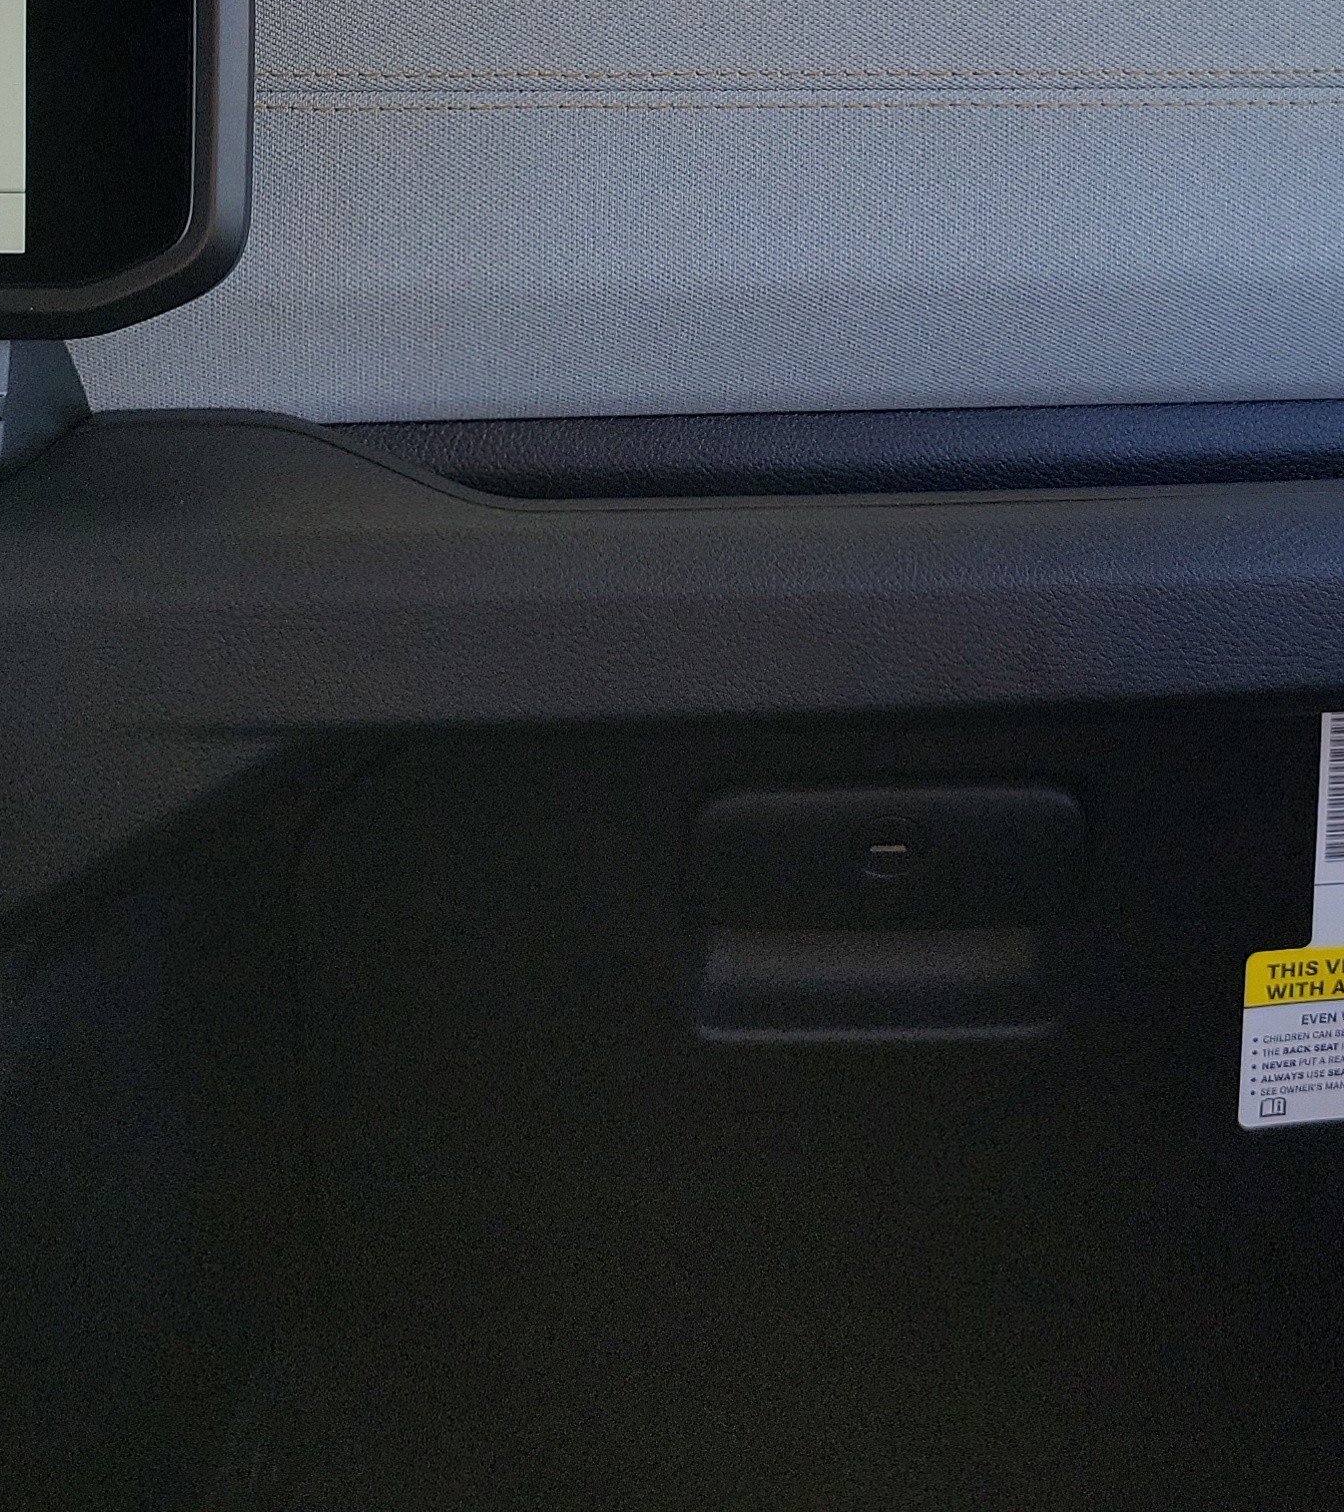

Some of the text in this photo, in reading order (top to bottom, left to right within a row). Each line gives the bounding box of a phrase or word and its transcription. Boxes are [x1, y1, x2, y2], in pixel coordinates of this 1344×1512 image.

[1267, 960, 1319, 979] THIS
[1267, 980, 1324, 1000] WITH
[1301, 1012, 1337, 1025] EVEN
[1314, 1042, 1338, 1052] SEAT
